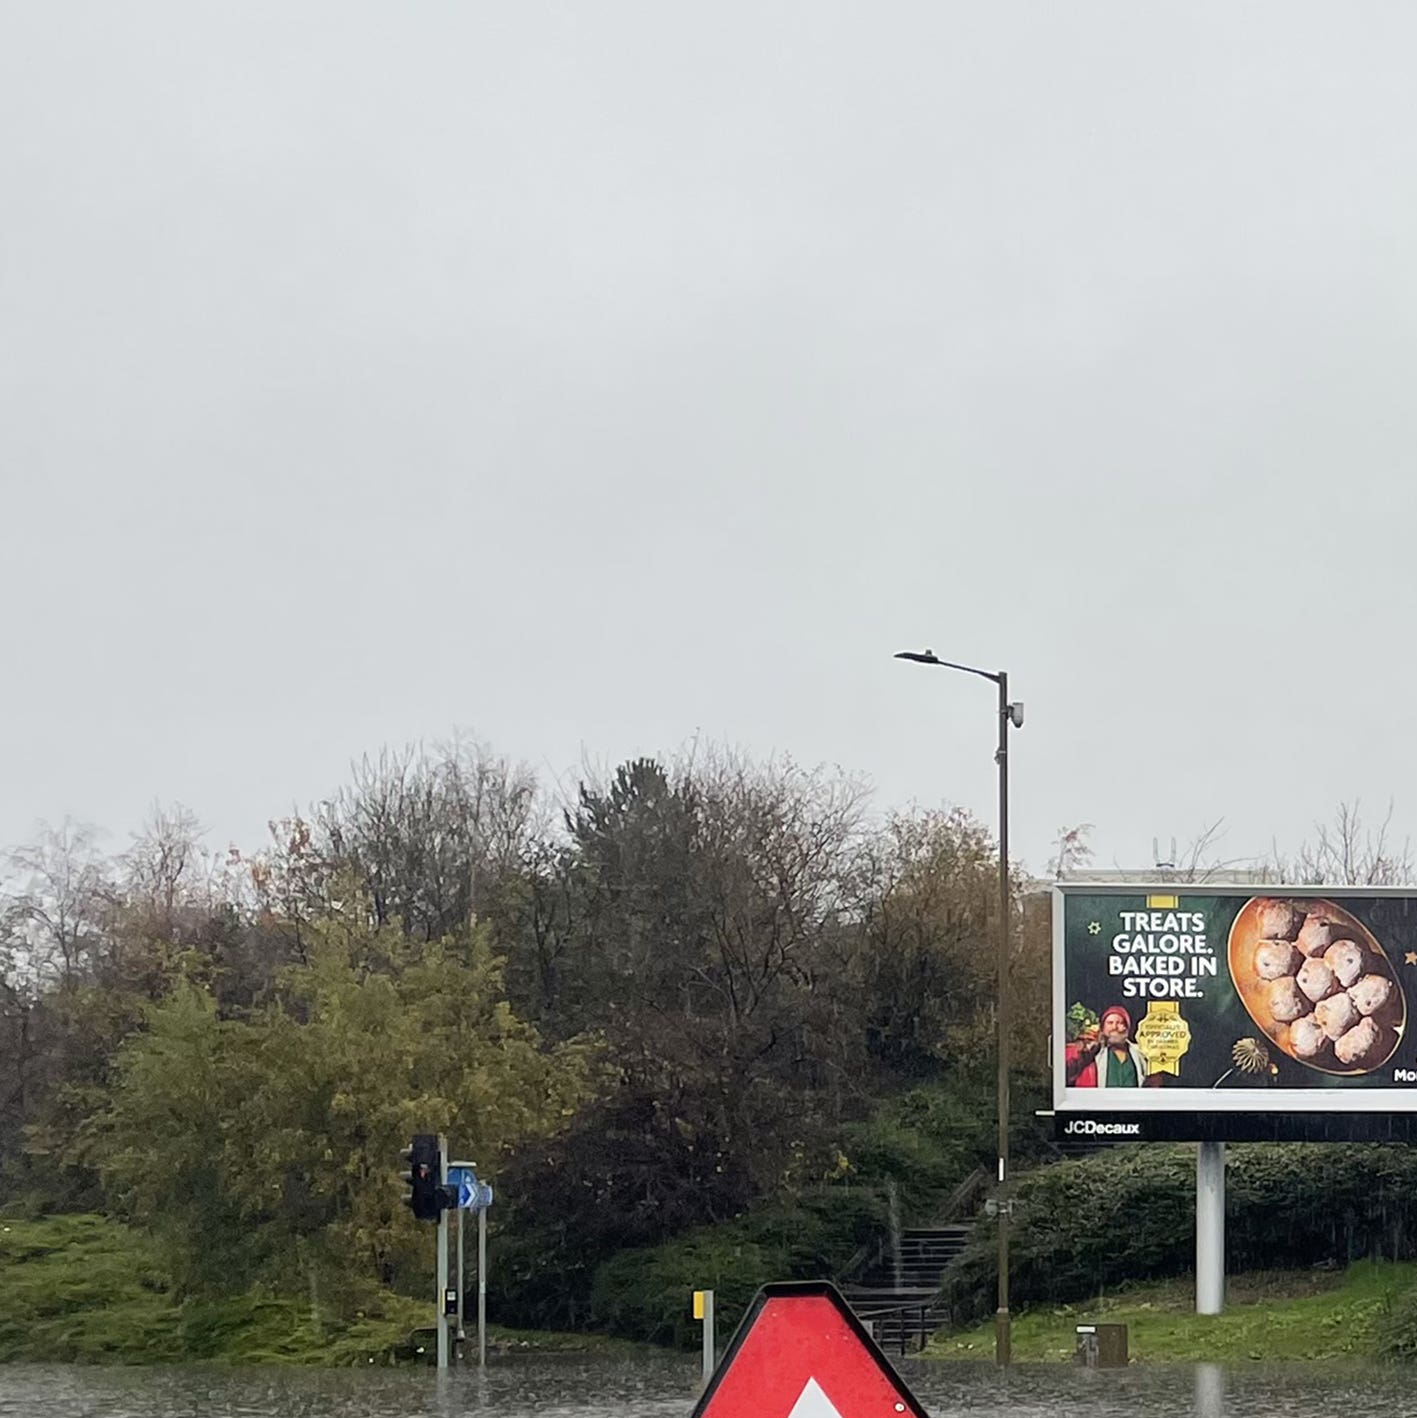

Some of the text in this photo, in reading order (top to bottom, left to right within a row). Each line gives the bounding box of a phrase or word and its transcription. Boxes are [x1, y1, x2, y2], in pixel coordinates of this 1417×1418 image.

[1119, 912, 1205, 932] TREATS
[1112, 934, 1214, 954] GALORE.
[1109, 956, 1217, 976] BAKED IN
[1123, 978, 1204, 998] STORE.
[1064, 1120, 1140, 1134] JCDecaux
